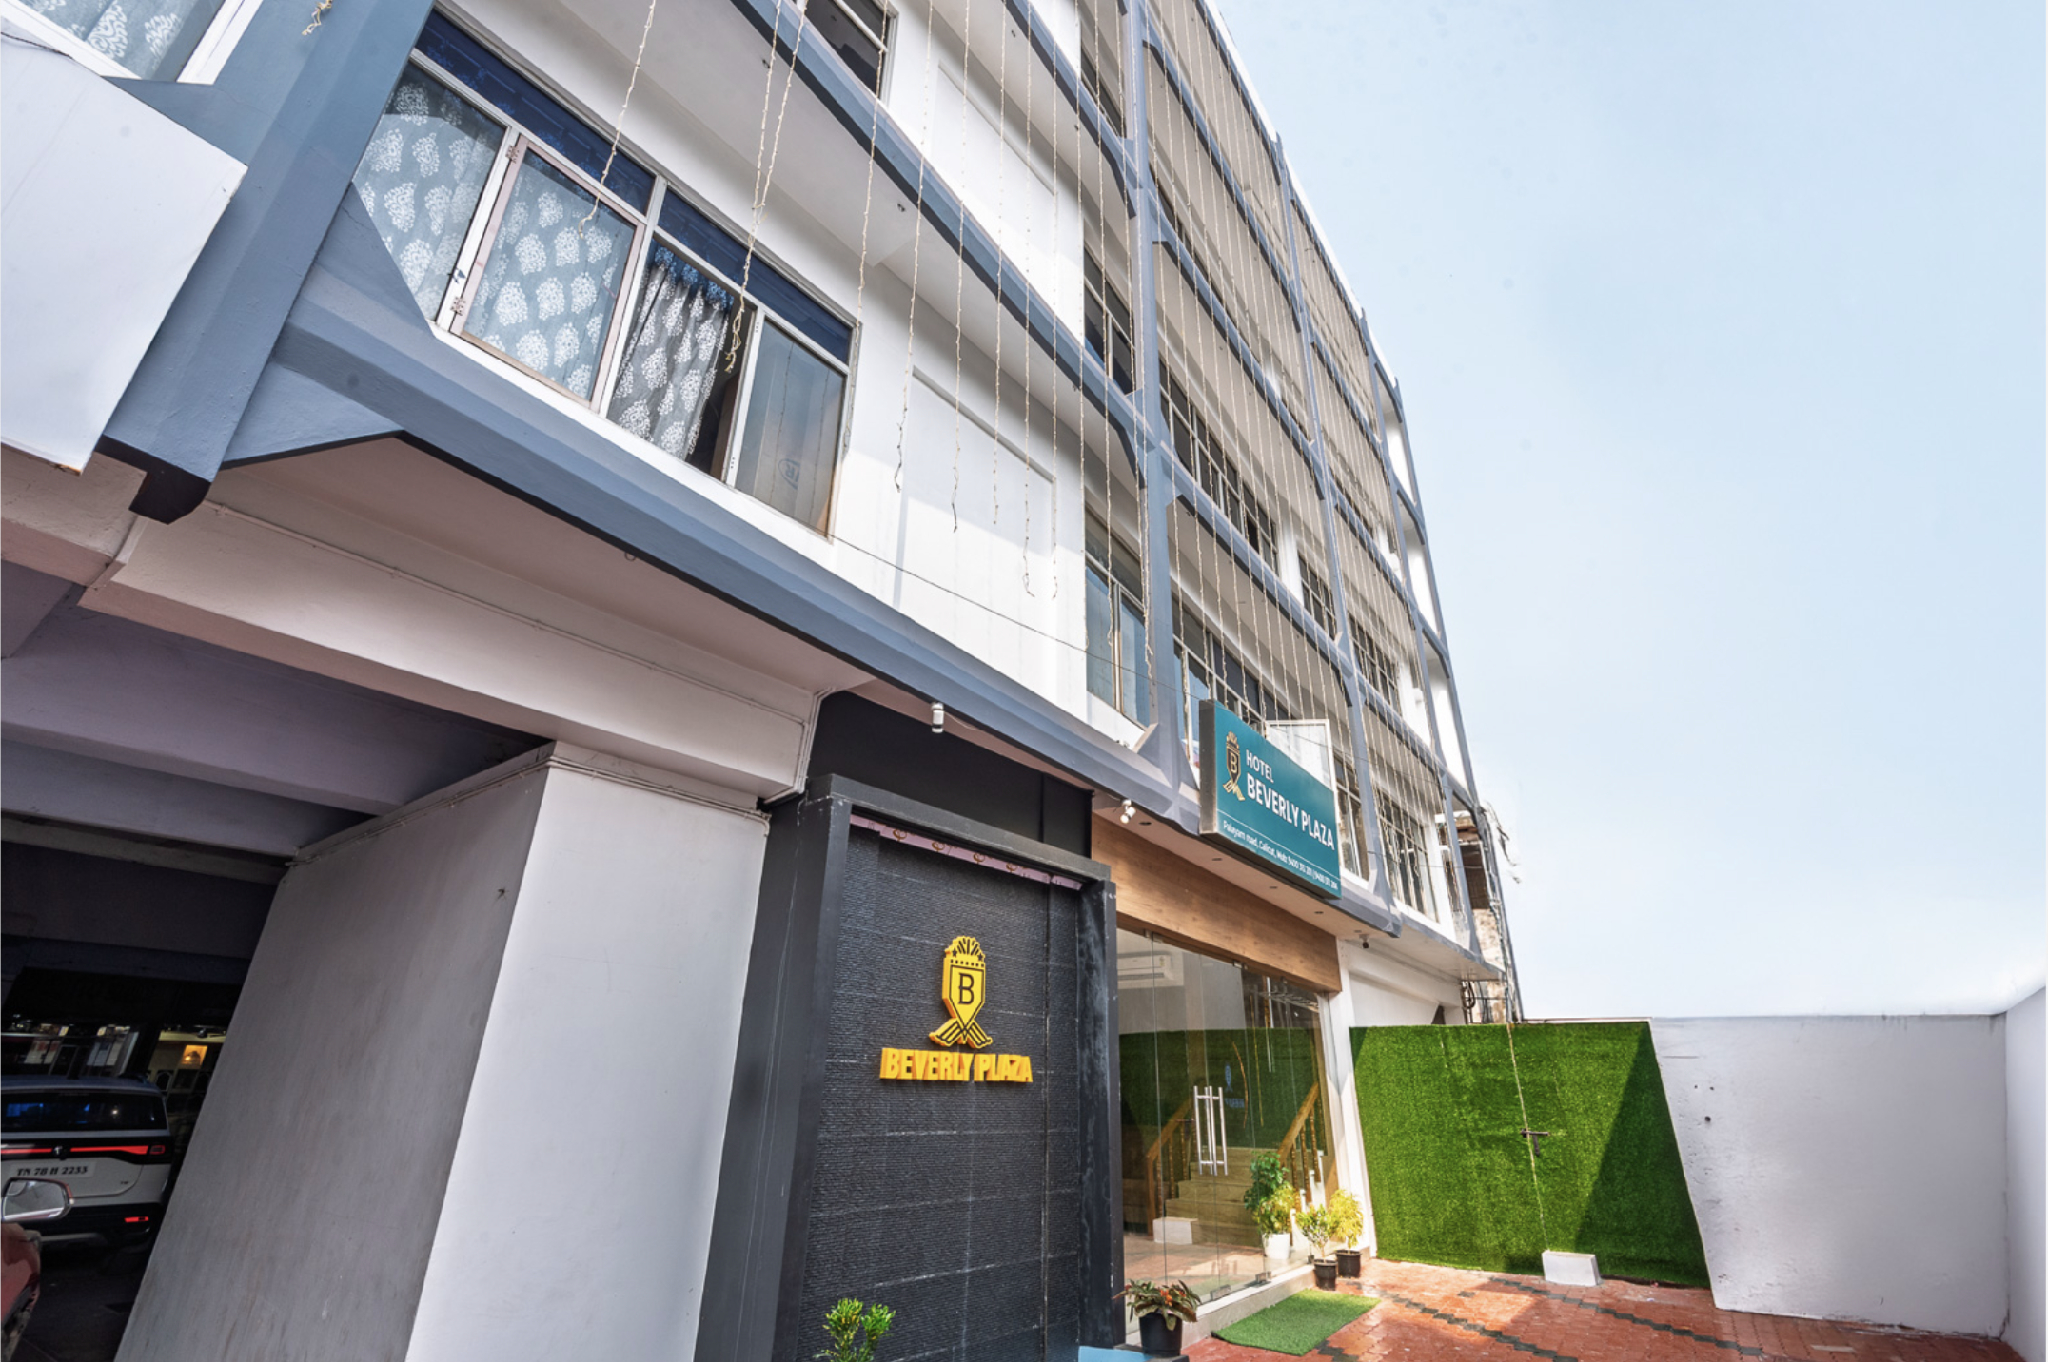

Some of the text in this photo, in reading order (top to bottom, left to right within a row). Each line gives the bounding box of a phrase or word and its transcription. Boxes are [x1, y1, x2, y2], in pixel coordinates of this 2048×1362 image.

[1246, 749, 1274, 783] HOTEL
[1247, 772, 1335, 851] BEVERLY PLAZA
[958, 972, 975, 1005] B
[879, 1047, 1034, 1083] BEVERLY PLAZA
